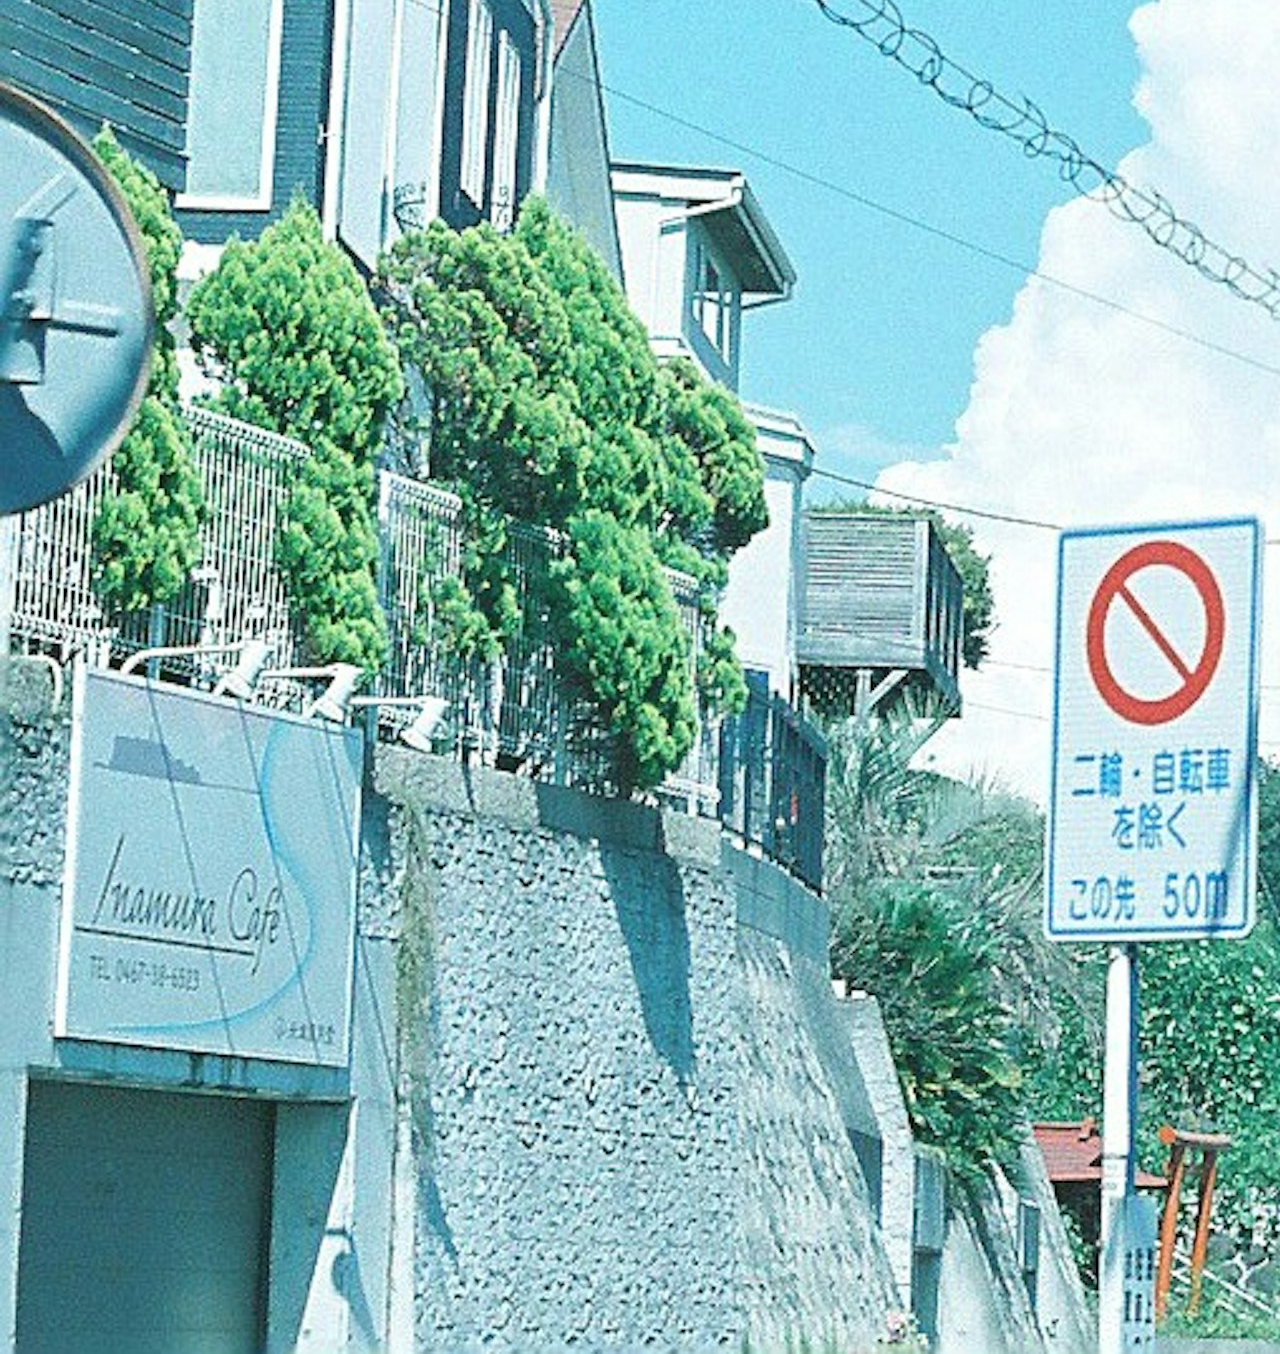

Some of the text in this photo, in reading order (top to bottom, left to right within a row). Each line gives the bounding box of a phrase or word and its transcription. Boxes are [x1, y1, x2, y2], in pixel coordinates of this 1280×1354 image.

[1071, 747, 1231, 798] 二輪・自転車
[1111, 801, 1187, 850] を除く
[92, 833, 216, 936] Inamura
[1068, 871, 1228, 922] この先 50m
